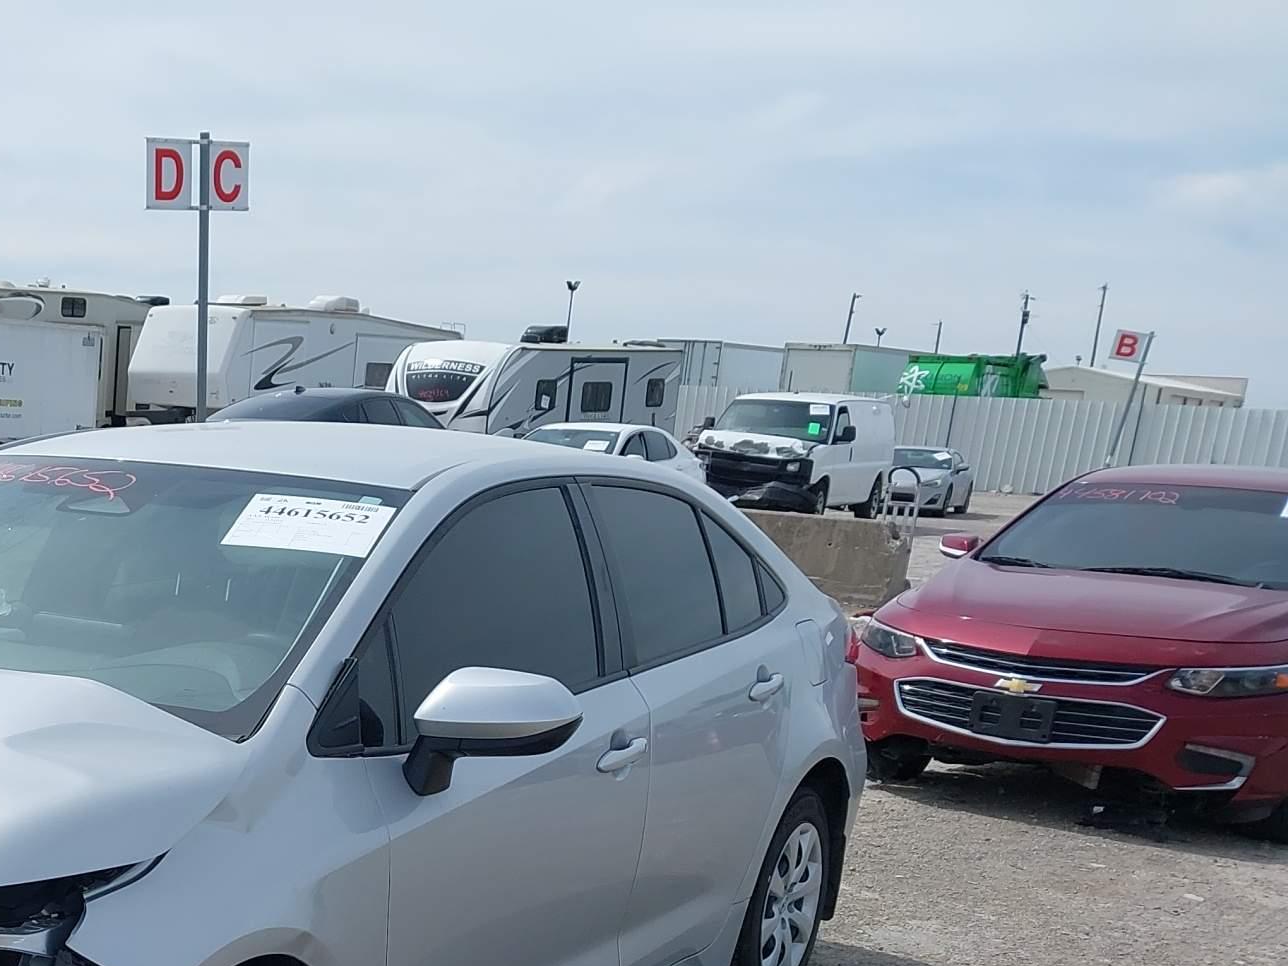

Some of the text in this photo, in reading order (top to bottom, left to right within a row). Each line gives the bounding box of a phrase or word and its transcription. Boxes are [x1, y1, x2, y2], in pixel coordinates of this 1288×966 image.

[155, 148, 184, 200] D
[214, 150, 241, 202] C
[1116, 334, 1138, 357] B
[410, 360, 481, 373] WILDERNESS
[259, 505, 371, 524] 44615652
